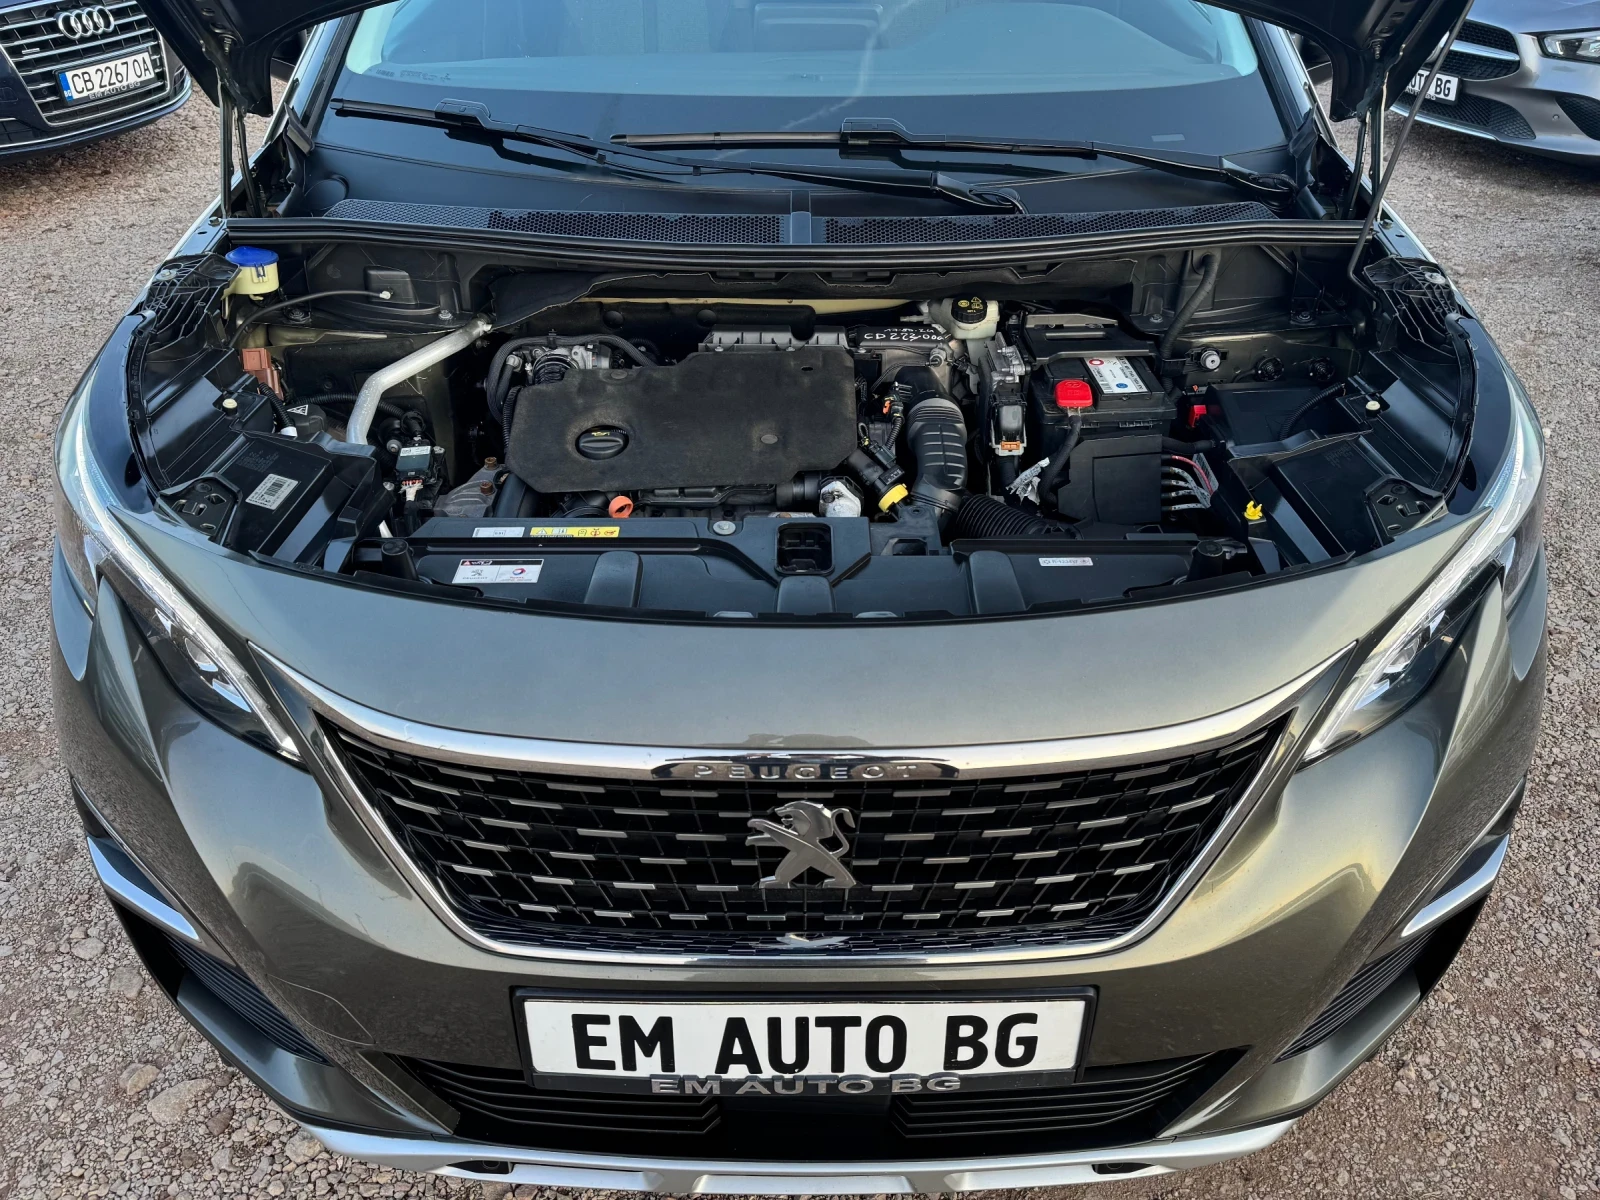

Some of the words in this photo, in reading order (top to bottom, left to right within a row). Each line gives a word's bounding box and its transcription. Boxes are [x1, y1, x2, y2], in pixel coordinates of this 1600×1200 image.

[72, 72, 94, 94] CB
[95, 62, 128, 88] 2267
[133, 57, 151, 78] OA
[104, 84, 127, 95] AUTO
[129, 81, 140, 90] BG
[1436, 78, 1451, 97] BG
[694, 765, 917, 780] PEUGEOT
[571, 1013, 676, 1073] EM
[715, 1014, 908, 1075] AUTO
[943, 1012, 1039, 1072] BG
[650, 1076, 721, 1095] EM
[735, 1076, 874, 1095] AUTO
[890, 1074, 961, 1094] BG
